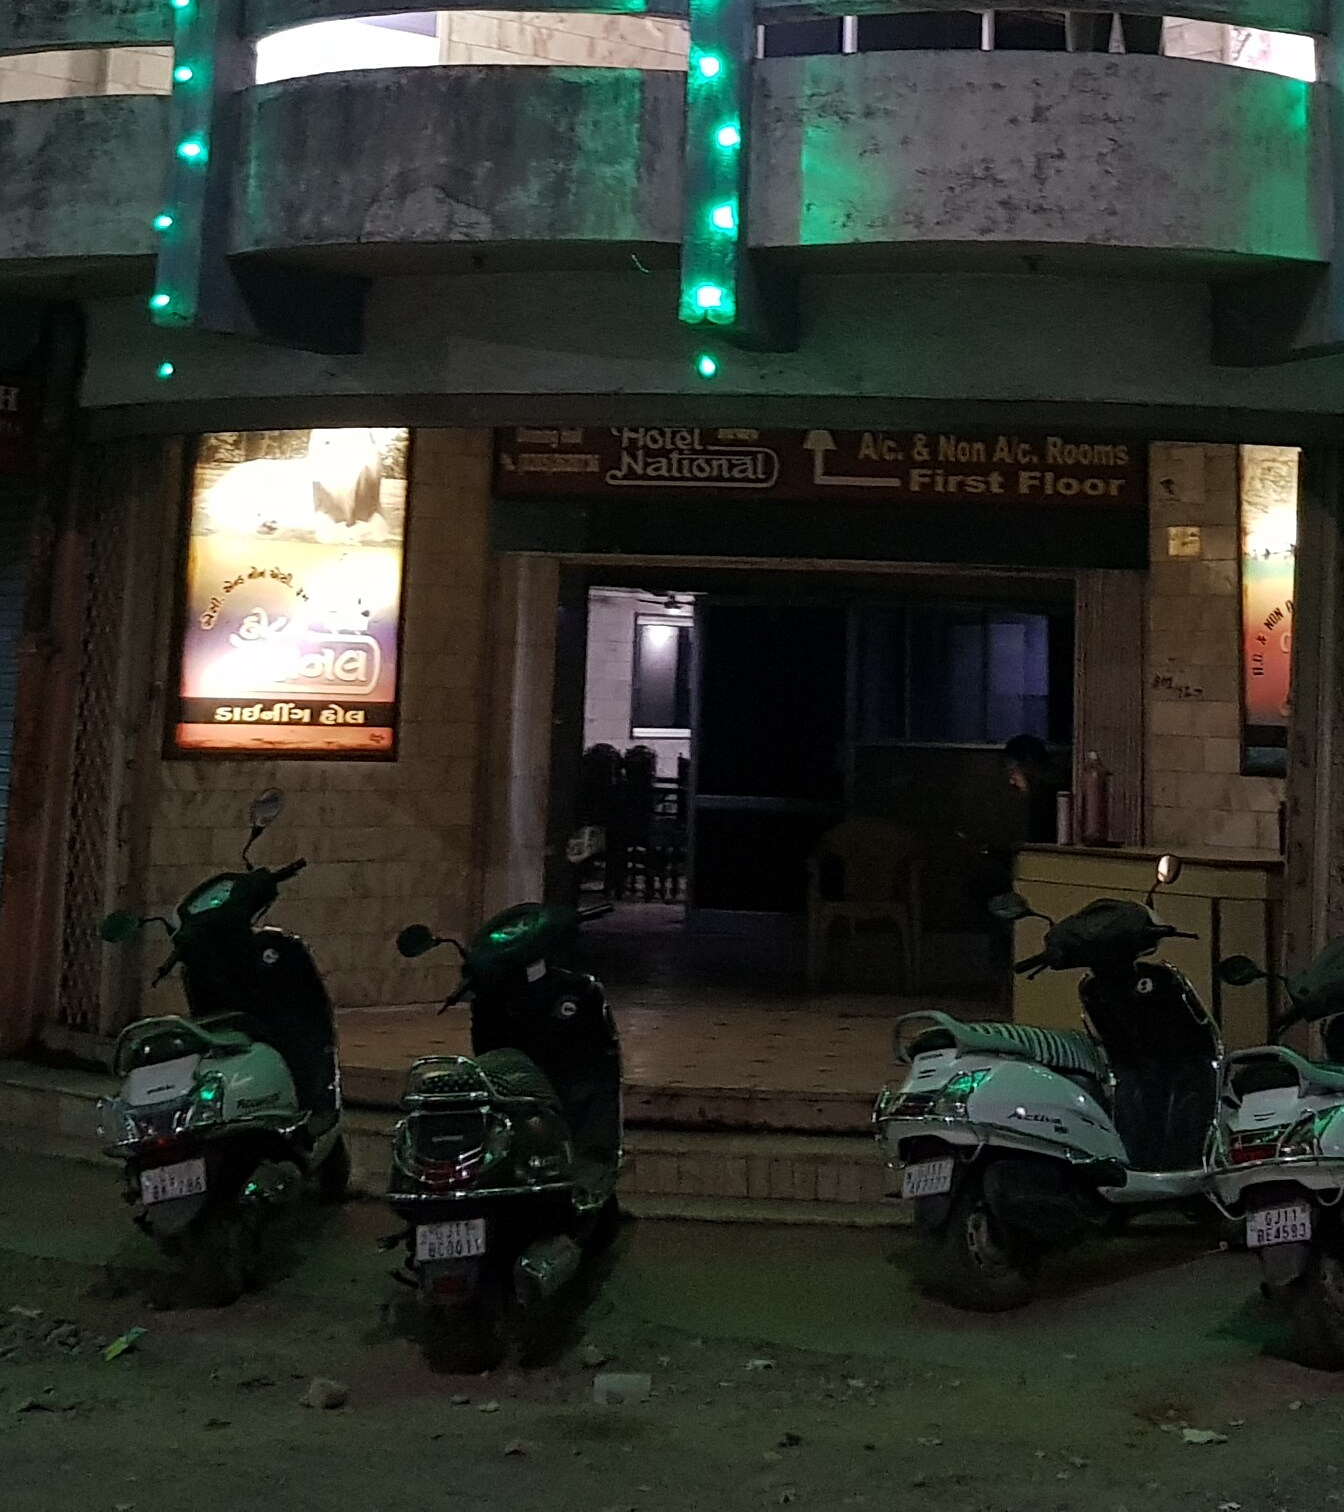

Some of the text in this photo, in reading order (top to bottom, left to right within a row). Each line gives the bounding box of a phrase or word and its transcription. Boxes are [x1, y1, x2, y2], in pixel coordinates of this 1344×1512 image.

[912, 432, 931, 462] &
[937, 434, 986, 463] Non
[1045, 435, 1131, 467] Rooms
[621, 449, 769, 480] National
[907, 468, 1126, 497] First Floor
[1263, 606, 1285, 631] NON
[320, 704, 365, 725] હોલ
[1264, 1208, 1297, 1226] GJ11
